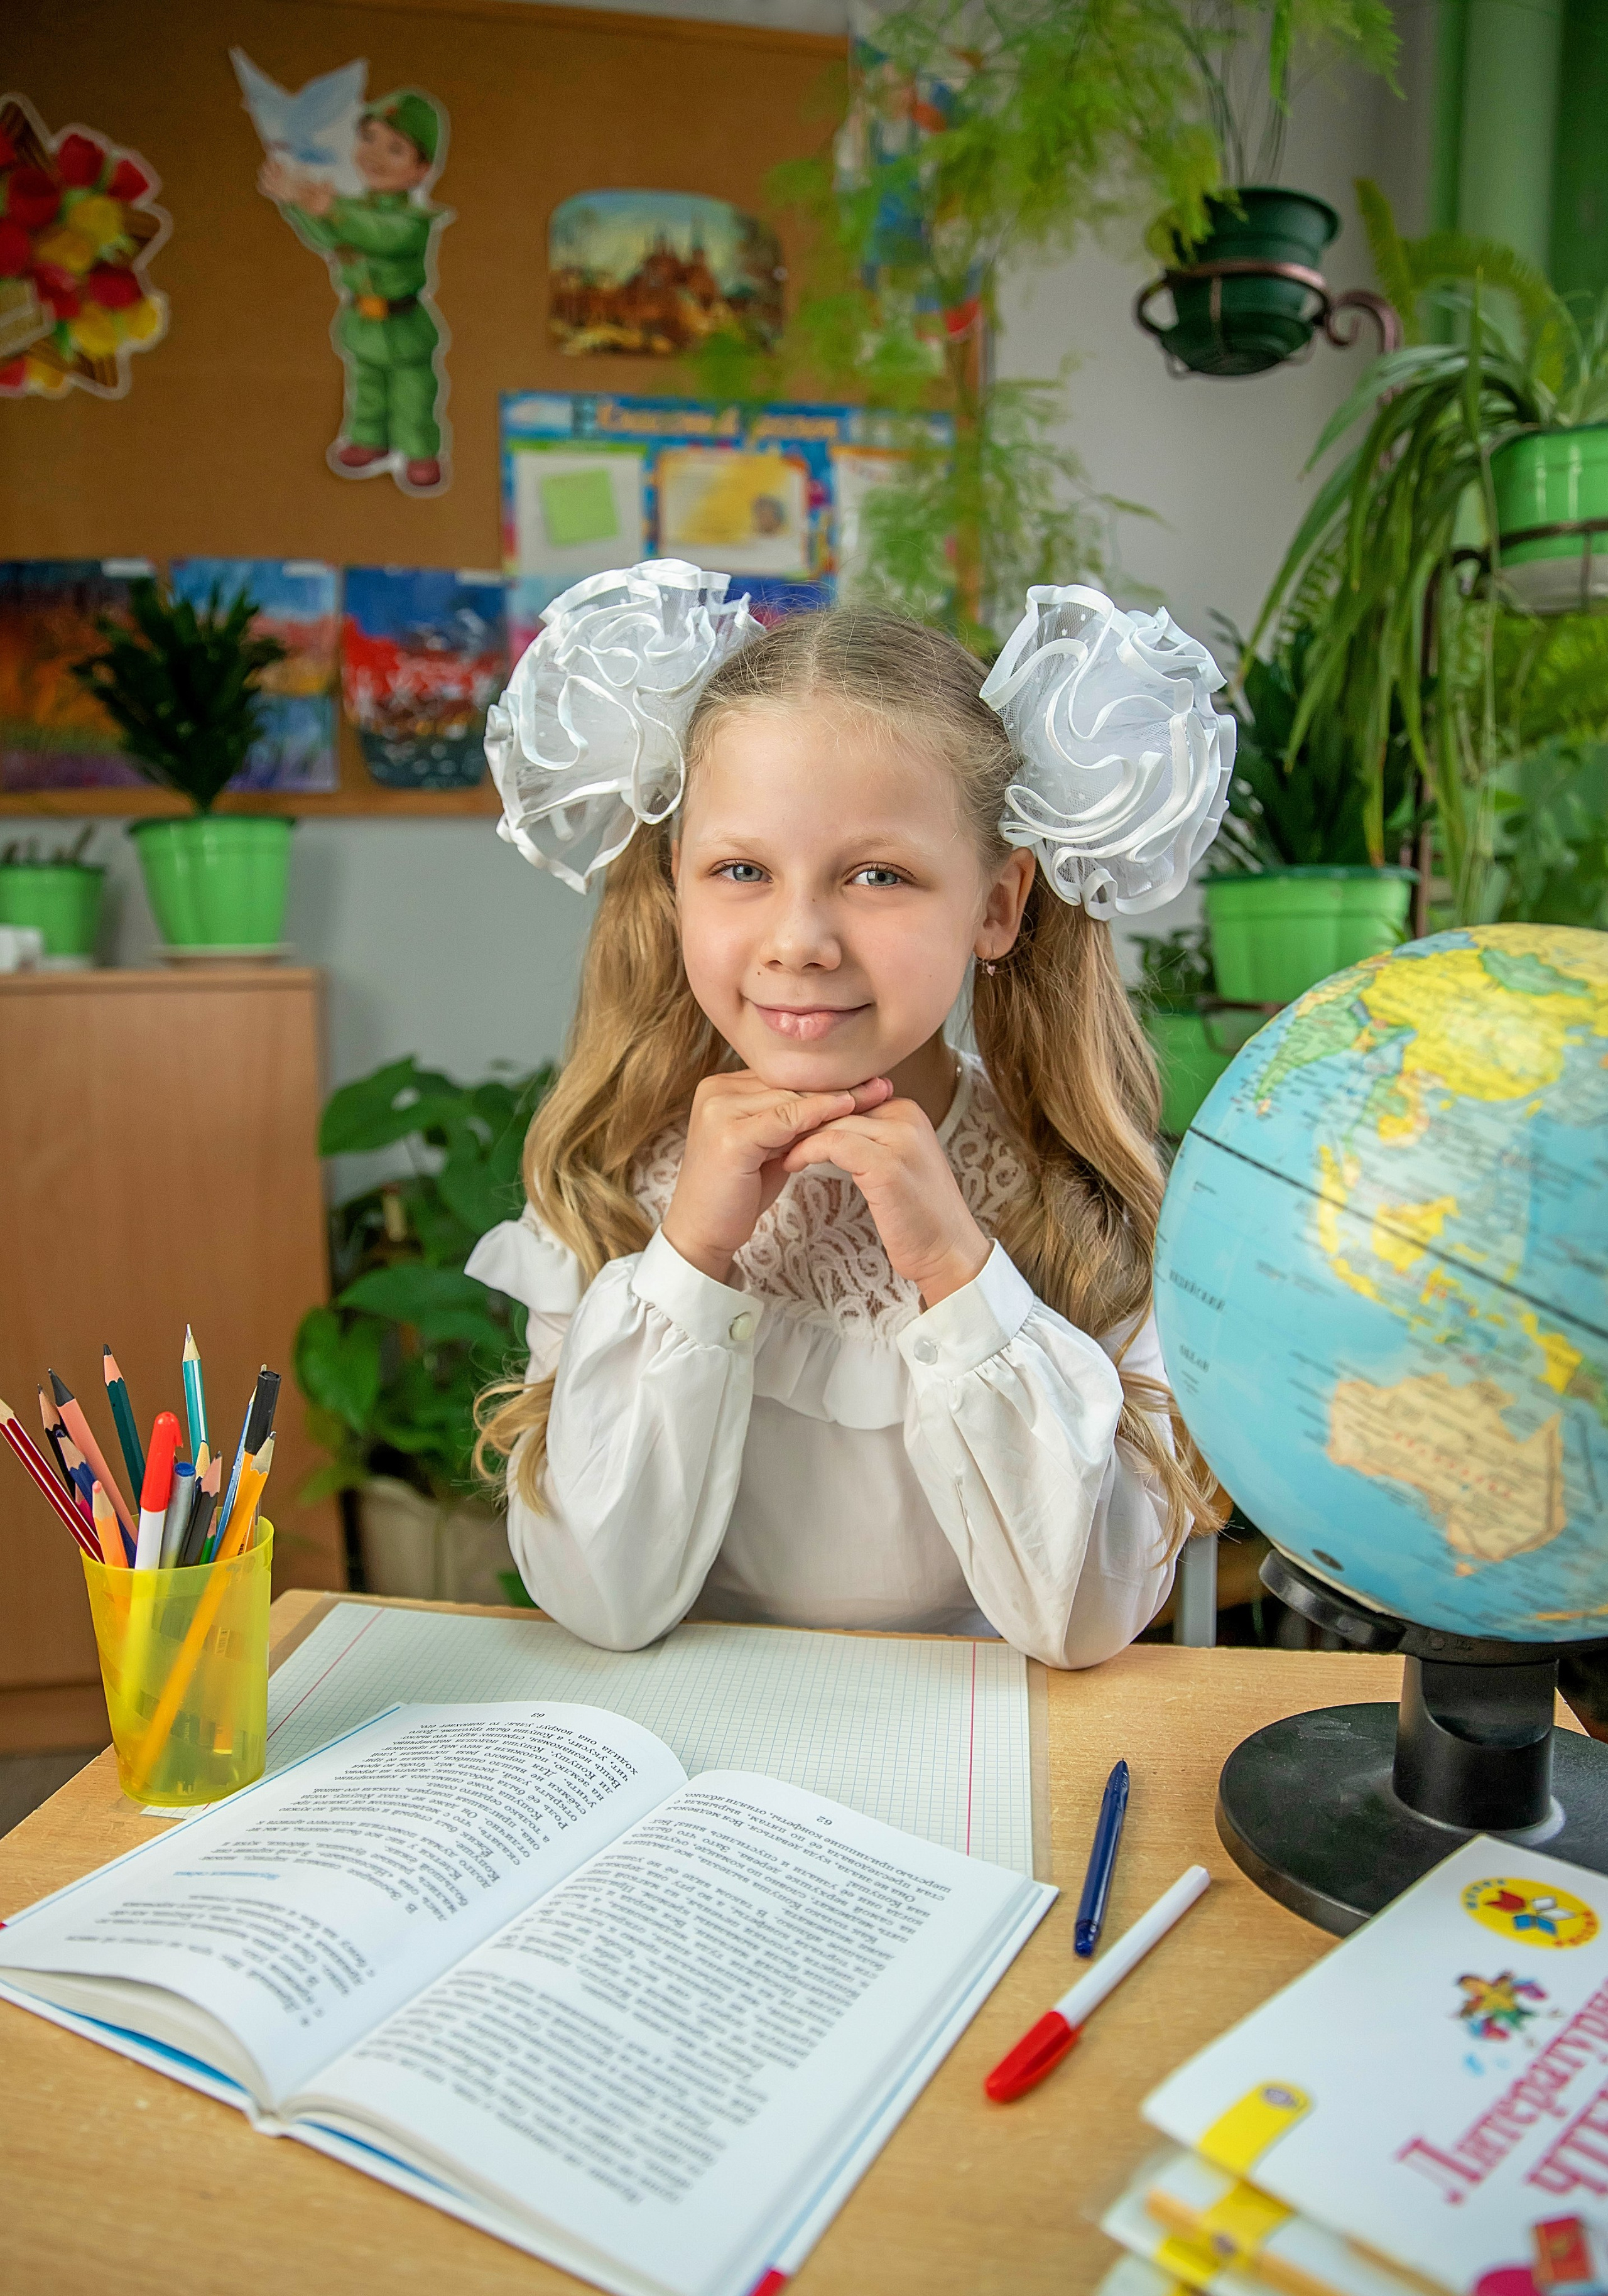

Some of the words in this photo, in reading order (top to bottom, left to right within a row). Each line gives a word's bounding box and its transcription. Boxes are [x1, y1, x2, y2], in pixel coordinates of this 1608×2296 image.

[440, 1726, 484, 1734] труслива.
[512, 1728, 555, 1740] Копуша
[535, 1724, 575, 1736] вокруг
[501, 1740, 546, 1754] Копуша
[577, 1734, 598, 1746] она
[483, 1752, 526, 1765] первого
[492, 1746, 550, 1763] положили
[528, 1736, 593, 1765] незнакомая,
[567, 1738, 609, 1762] укусит,
[443, 1755, 487, 1764] ошибки,
[488, 1760, 528, 1775] вышло
[550, 1750, 597, 1782] Копушу.
[601, 1745, 639, 1777] ходила
[457, 1763, 500, 1774] достать
[531, 1763, 558, 1779] Для
[553, 1761, 590, 1788] землю,
[594, 1763, 622, 1790] Вещь
[609, 1761, 629, 1783] чит,
[410, 1774, 465, 1784] снималась
[426, 1782, 458, 1791] сопел.
[465, 1780, 496, 1793] тоже
[501, 1770, 533, 1787] улей,
[530, 1773, 546, 1783] не
[496, 1779, 526, 1796] была
[563, 1778, 597, 1809] учить.
[590, 1787, 605, 1802] на
[597, 1780, 614, 1795] ли
[458, 1787, 503, 1807] сердито
[497, 1789, 544, 1822] Копуша
[525, 1794, 541, 1804] её
[533, 1785, 578, 1822] открыть
[546, 1781, 587, 1816] съёмки
[683, 1799, 743, 1816] вырывала
[724, 1797, 768, 1816] отняли
[503, 1805, 542, 1836] только
[543, 1804, 568, 1831] Роль
[720, 1814, 746, 1828] Вся
[747, 1813, 788, 1834] пятам,
[769, 1812, 825, 1840] конфеты,
[815, 1815, 834, 1826] 62
[541, 1834, 551, 1844] а
[746, 1823, 804, 1851] деваться.
[790, 1833, 807, 1843] по
[807, 1841, 823, 1850] её
[710, 1830, 779, 1863] спустились
[823, 1837, 896, 1872] прилипшие
[454, 1840, 501, 1884] Копуше.
[780, 1860, 791, 1868] и
[801, 1848, 833, 1865] куда
[826, 1848, 912, 1890] преследовала
[834, 1861, 874, 1884] знала,
[791, 1865, 840, 1891] узнали
[872, 1881, 891, 1892] не
[894, 1869, 953, 1894] шерстью
[839, 1888, 855, 1898] её
[845, 1880, 903, 1909] Копуша!
[890, 1887, 916, 1903] Она
[915, 1887, 946, 1902] стая
[856, 1896, 884, 1910] они
[885, 1907, 925, 1927] когда
[905, 1905, 932, 1919] ная
